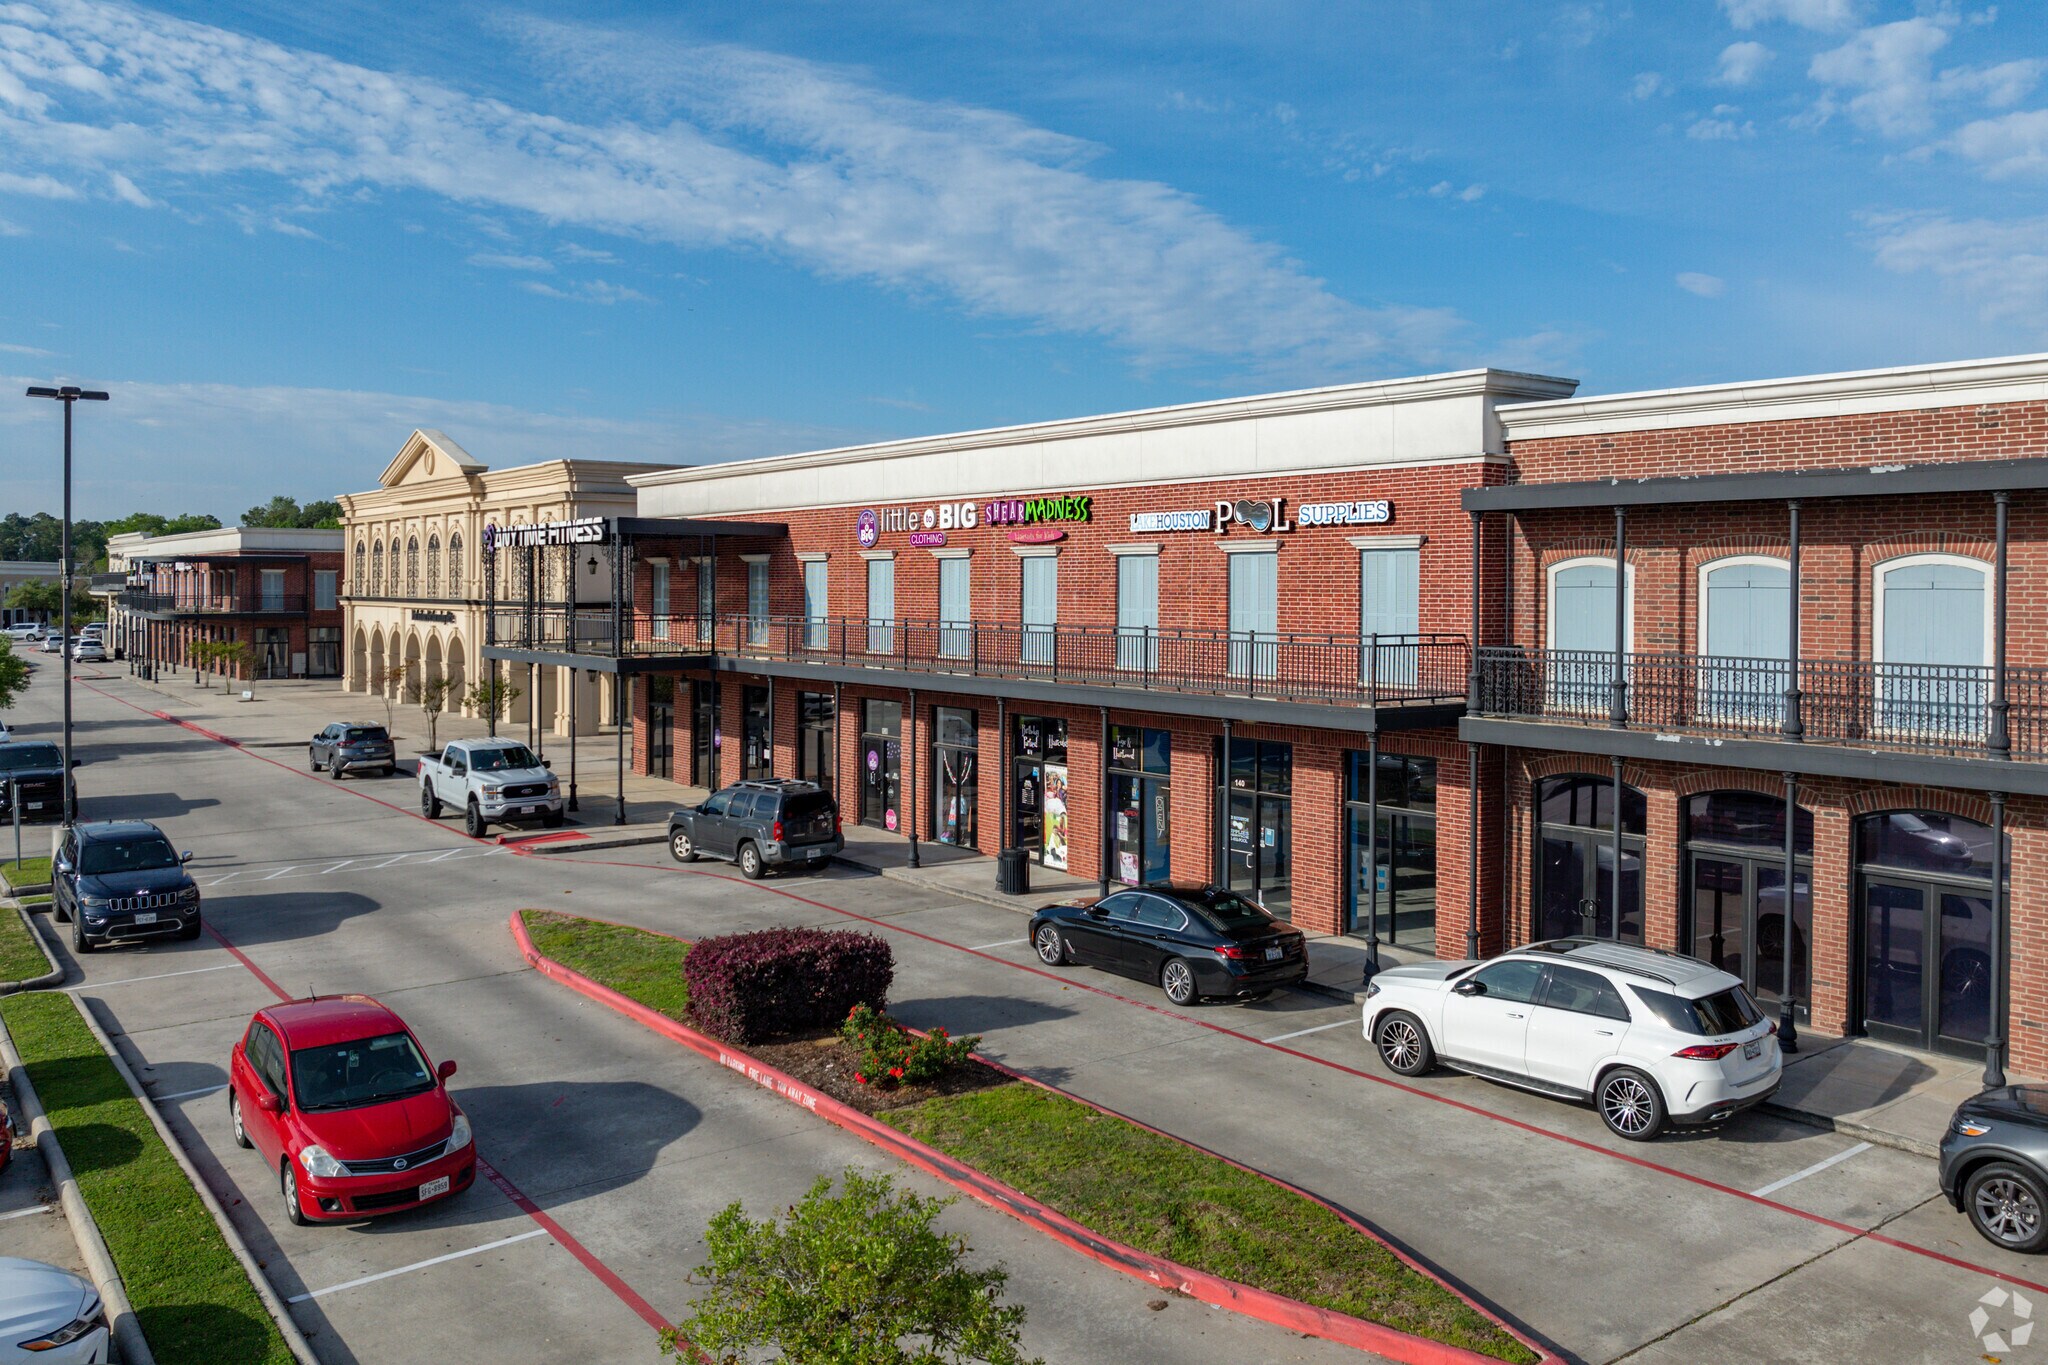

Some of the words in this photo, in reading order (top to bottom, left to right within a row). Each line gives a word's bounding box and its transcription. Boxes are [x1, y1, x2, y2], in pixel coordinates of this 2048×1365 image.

[881, 507, 918, 531] little
[940, 502, 976, 529] BIG
[986, 501, 1024, 523] SHEAR
[1024, 496, 1088, 522] MADNESS
[1299, 501, 1389, 525] SUPPLIES
[494, 524, 546, 547] ANYTIME
[547, 517, 603, 544] FITNESS
[911, 534, 943, 544] CLOTHING
[748, 1067, 760, 1081] FIRE
[760, 1073, 773, 1090] LANE
[788, 1086, 802, 1101] AWAY
[803, 1094, 816, 1111] ZONE
